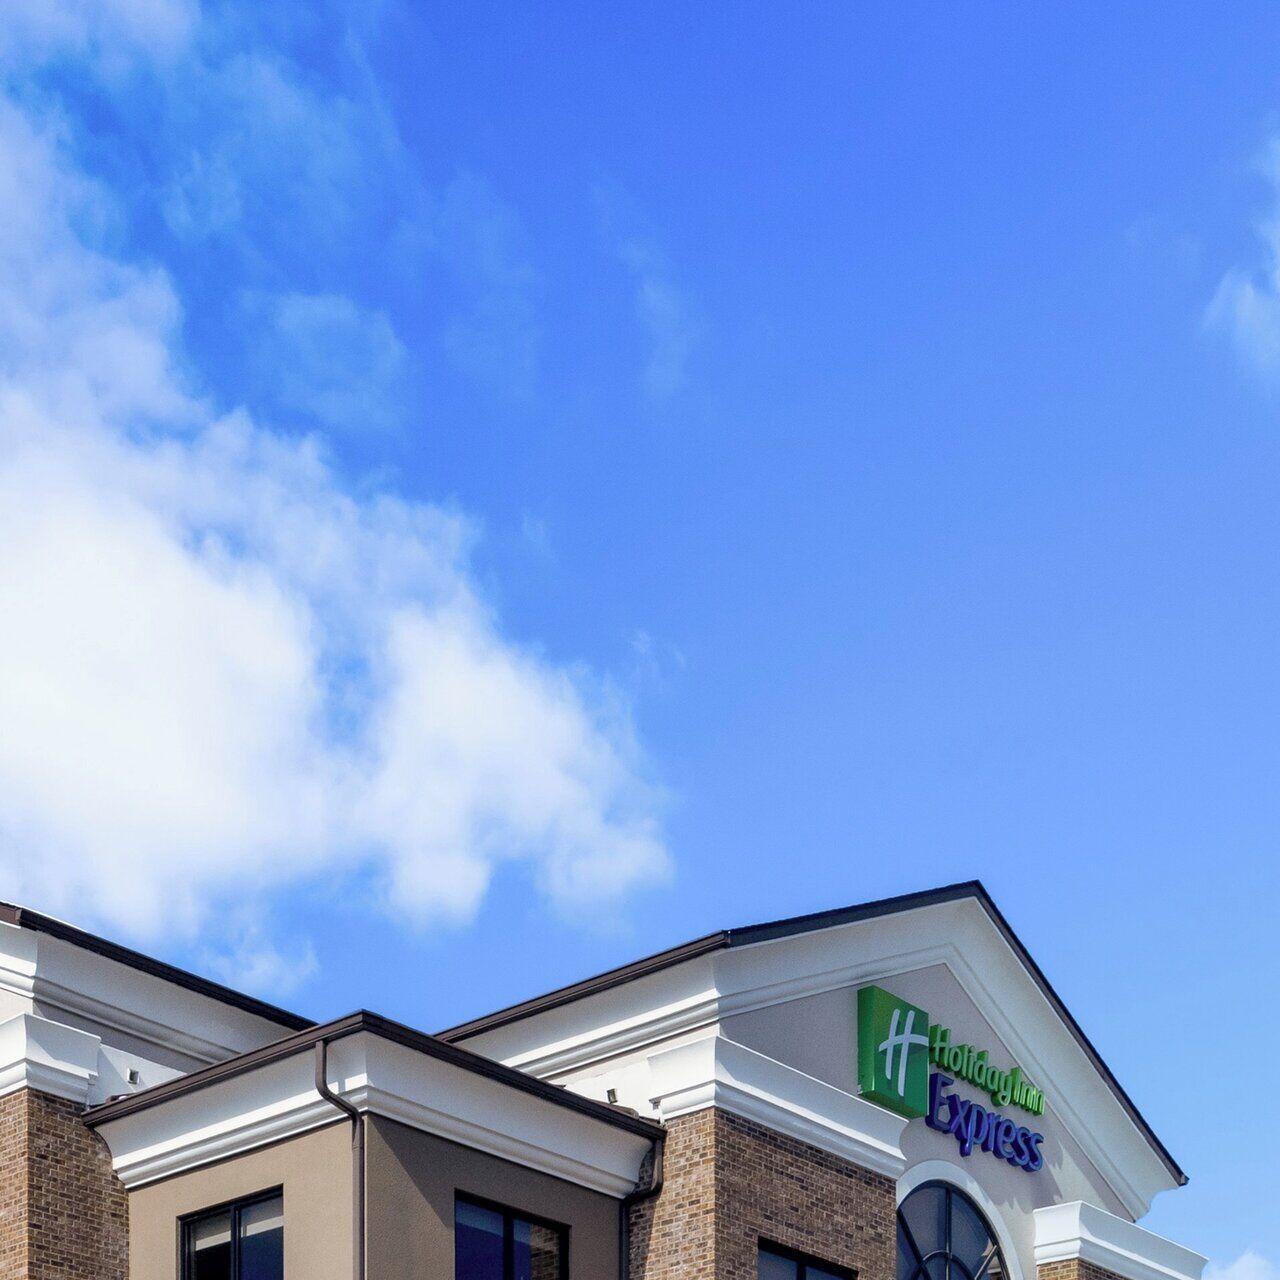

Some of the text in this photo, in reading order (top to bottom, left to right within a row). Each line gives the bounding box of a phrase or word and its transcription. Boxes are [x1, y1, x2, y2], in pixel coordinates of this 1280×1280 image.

[930, 1023, 1045, 1116] Holiday Inn
[925, 1072, 1044, 1172] Express
